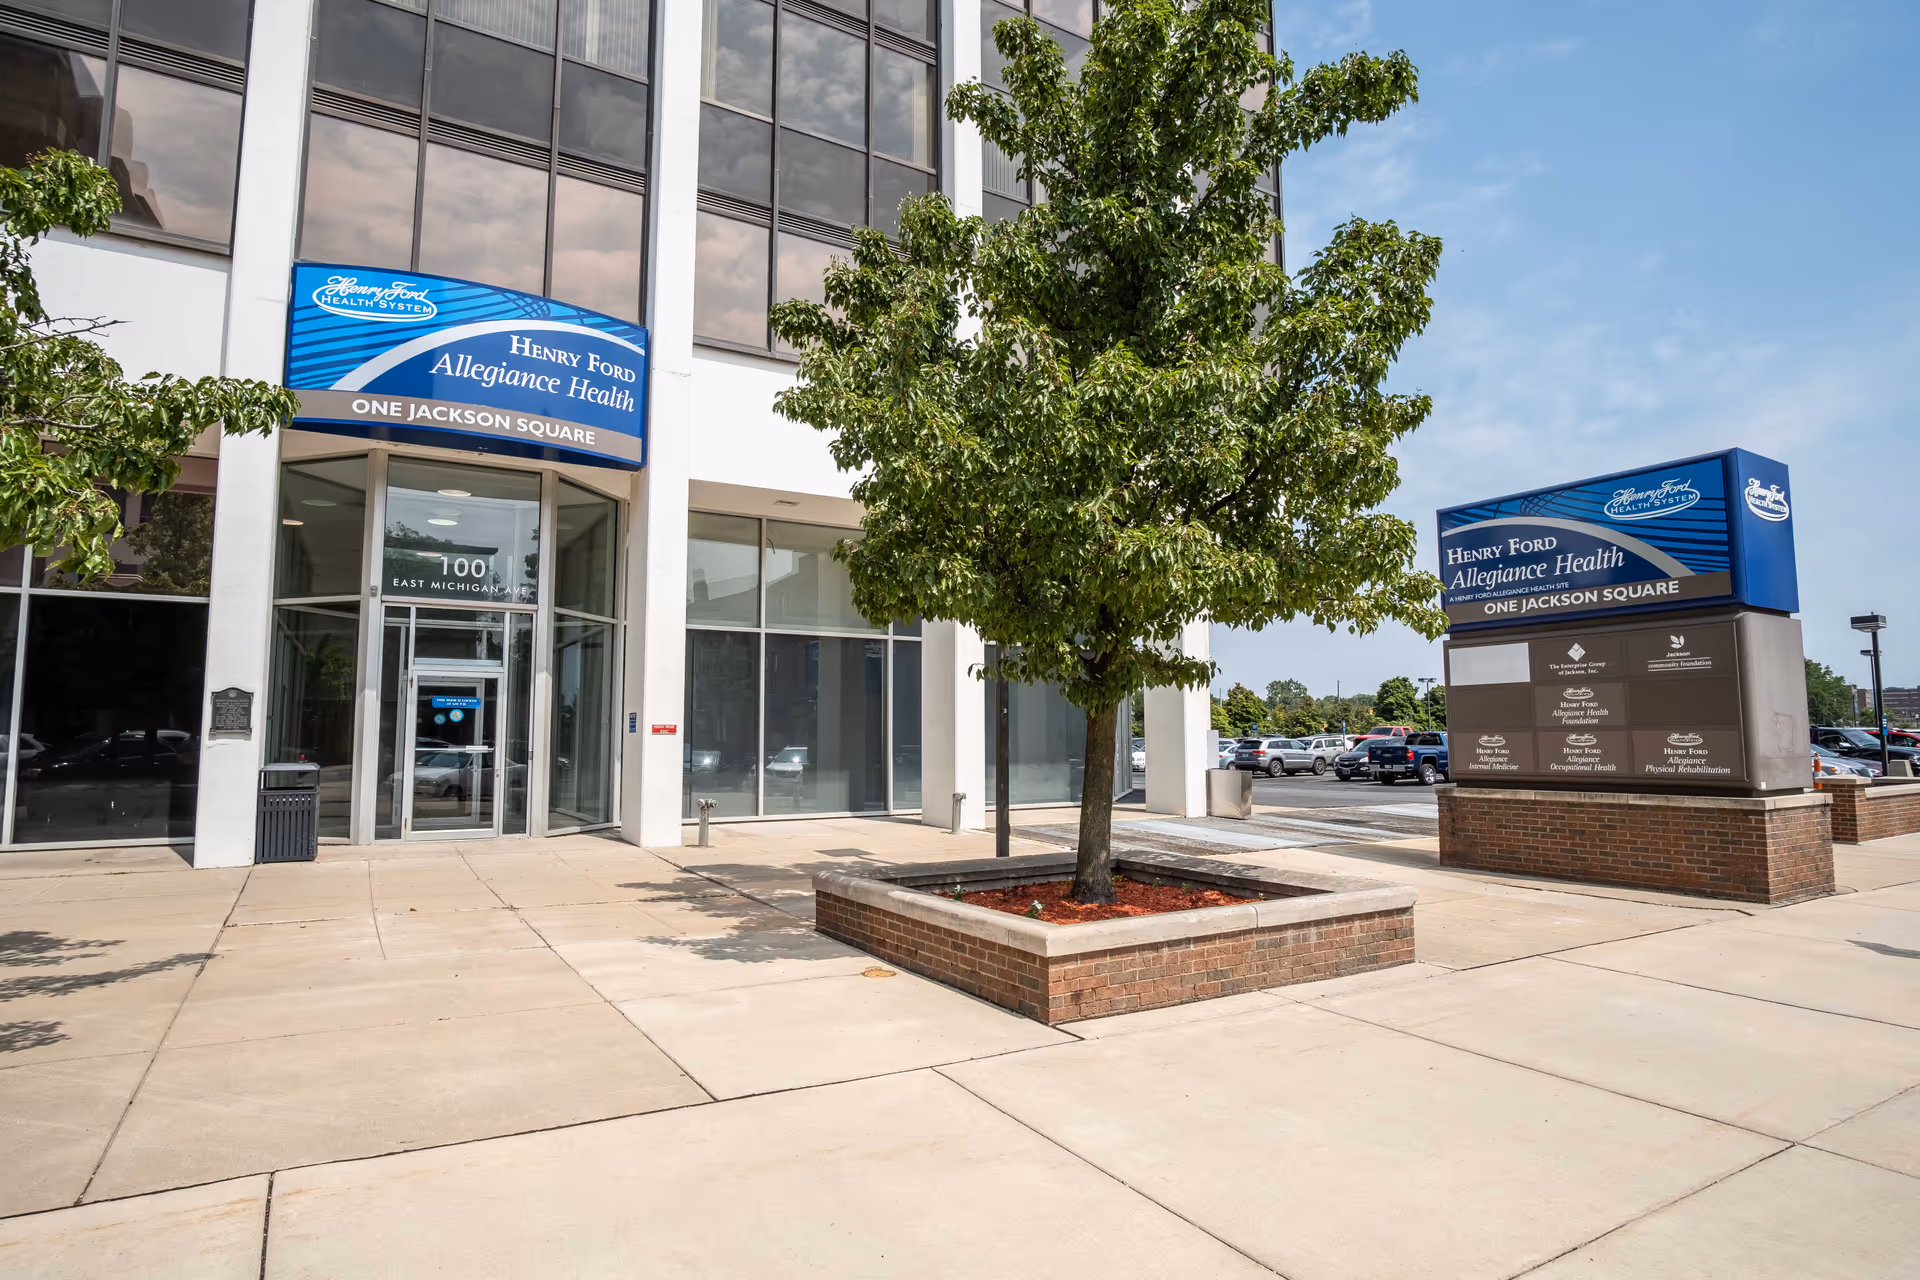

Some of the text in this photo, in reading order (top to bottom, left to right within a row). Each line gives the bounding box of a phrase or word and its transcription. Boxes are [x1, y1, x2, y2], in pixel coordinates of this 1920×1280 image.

[327, 276, 430, 301] Henry Ford
[321, 295, 432, 313] HEALTH SYSTEM
[509, 335, 636, 383] HENRY FORD
[429, 353, 636, 412] Allegiance Health
[351, 399, 596, 445] ONE JACKSON SQUARE
[1612, 478, 1692, 507] Henry Ford
[1610, 493, 1696, 514] HEALTH SYSTEM
[1447, 536, 1557, 566] HENRY FORD
[440, 556, 486, 578] 100
[1449, 546, 1625, 590] Allegiance Health
[393, 578, 527, 595] EAST MICHIGAN AVE
[1455, 594, 1474, 602] HENRY
[1492, 587, 1529, 598] ALLEGIANCE
[1530, 584, 1554, 592] HEALTH
[1484, 580, 1680, 616] ONE JACKSON SQUARE
[1552, 708, 1609, 718] Allegiance Health
[1550, 762, 1616, 772] Occupational Health
[1566, 755, 1600, 764] Allegiance
[1645, 764, 1731, 774] Physical Rehabilitation
[1667, 756, 1707, 766] Allegiance
